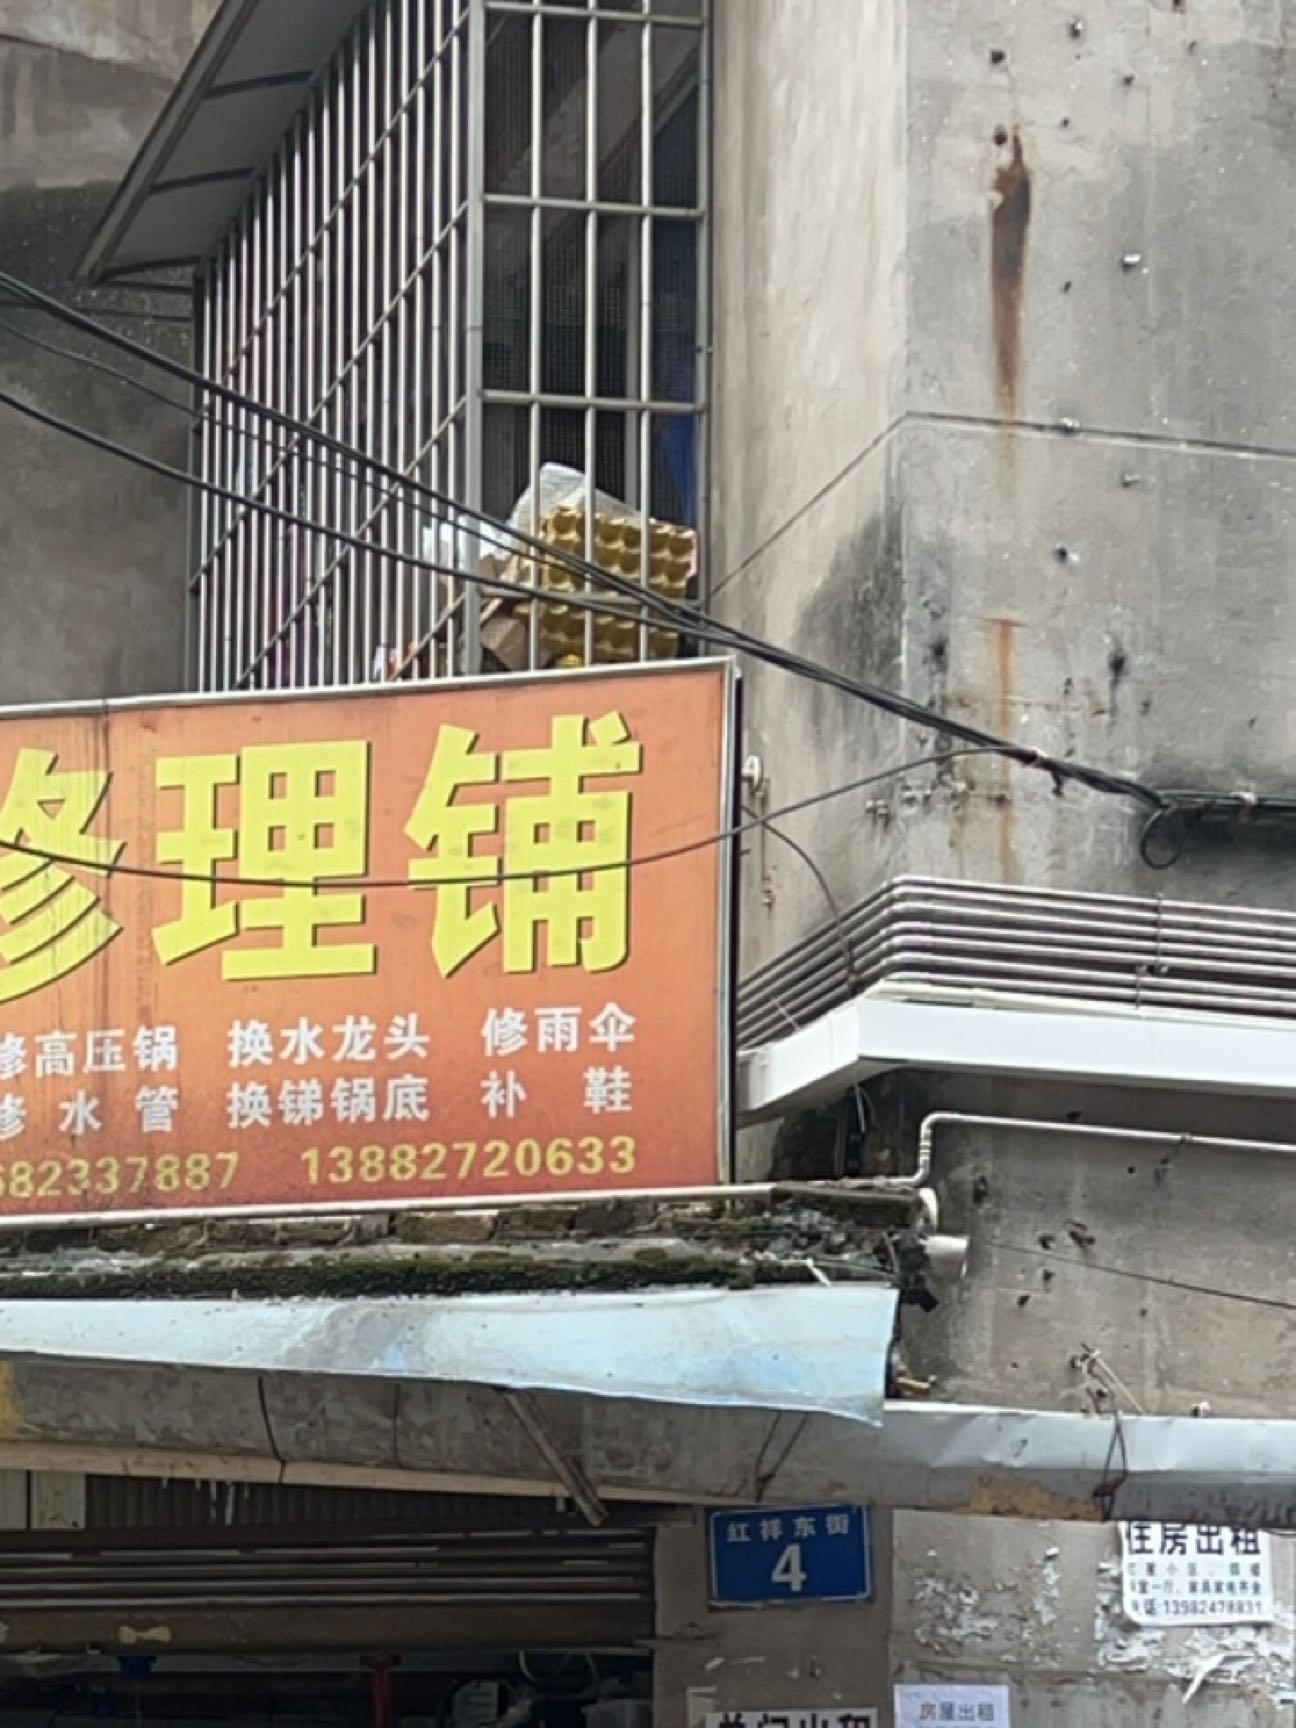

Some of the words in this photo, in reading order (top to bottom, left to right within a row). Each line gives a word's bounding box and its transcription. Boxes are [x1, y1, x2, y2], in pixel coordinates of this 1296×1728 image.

[227, 1013, 431, 1068] 换水龙头
[482, 1003, 637, 1057] 修雨伞
[227, 1075, 431, 1130] 换锑锅底
[301, 1136, 638, 1187] 13882720633
[1126, 1522, 1261, 1555] 住房出租
[771, 1543, 808, 1592] 4
